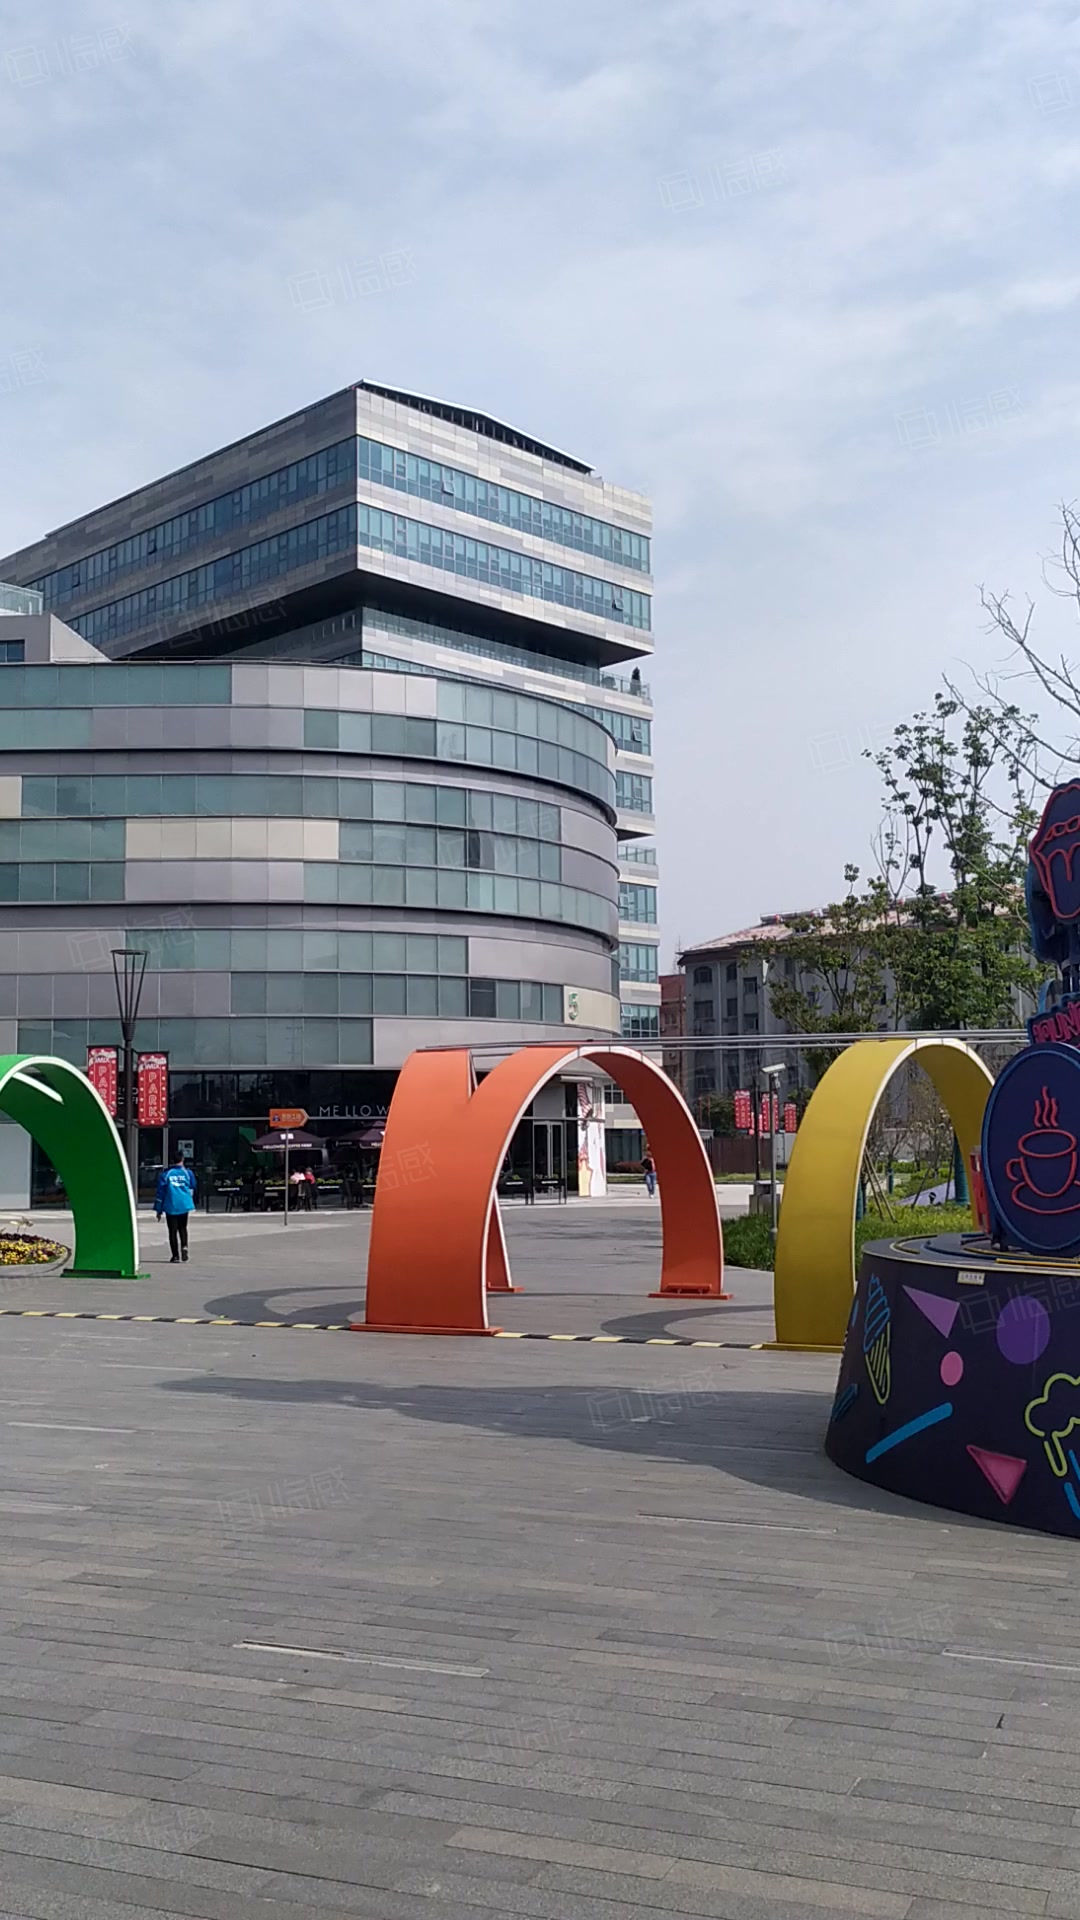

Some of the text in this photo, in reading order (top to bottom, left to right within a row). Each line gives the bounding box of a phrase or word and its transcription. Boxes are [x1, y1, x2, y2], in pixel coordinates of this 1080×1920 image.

[568, 992, 580, 1021] 5
[98, 1066, 108, 1106] PAR
[148, 1072, 158, 1117] PARK
